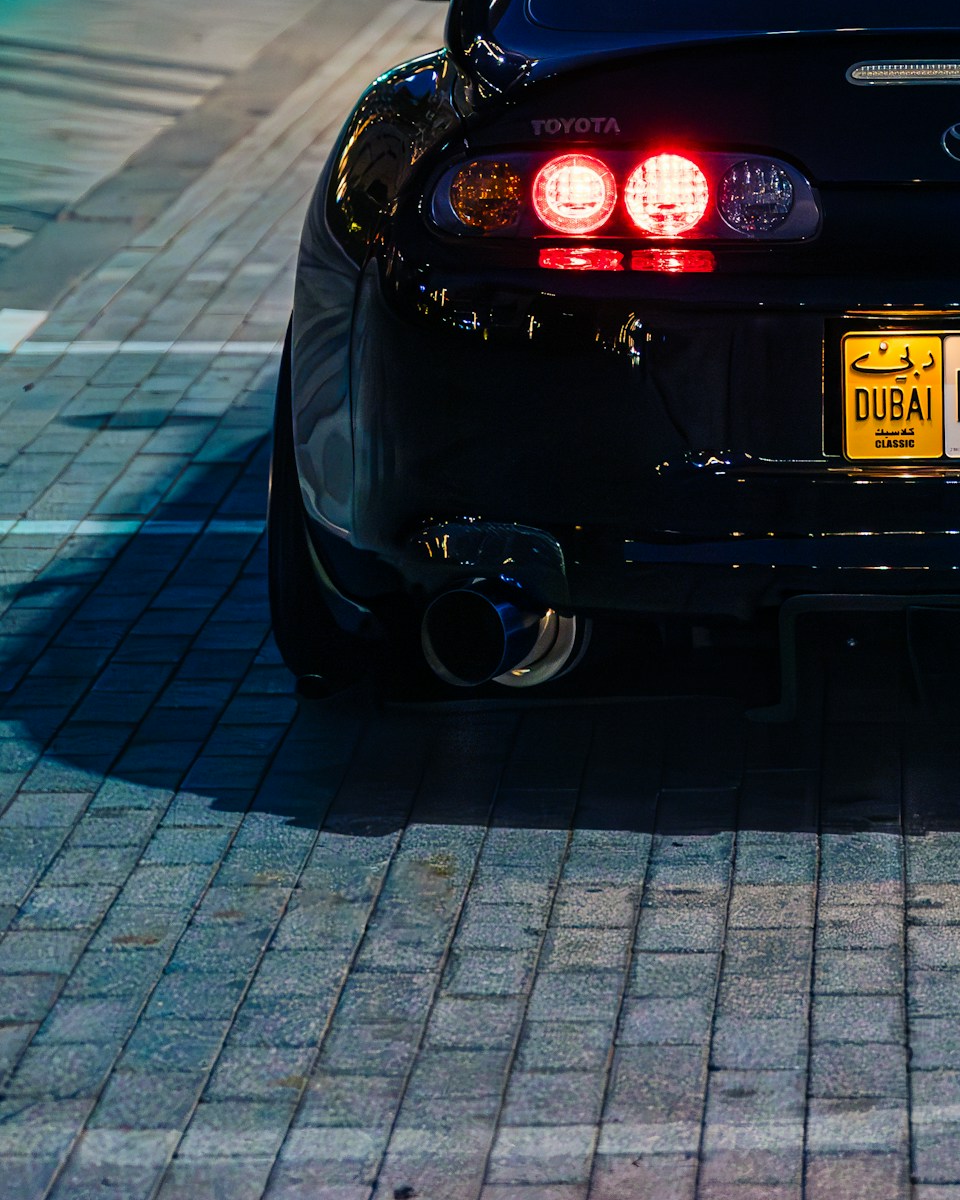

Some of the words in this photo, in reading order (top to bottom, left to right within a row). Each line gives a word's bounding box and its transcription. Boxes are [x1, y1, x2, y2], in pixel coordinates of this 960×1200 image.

[530, 117, 621, 135] TOYOTA
[851, 345, 935, 383] دبي
[855, 386, 932, 422] DUBAI
[875, 428, 915, 439] كلاسيك
[875, 439, 915, 448] CLASSIC
